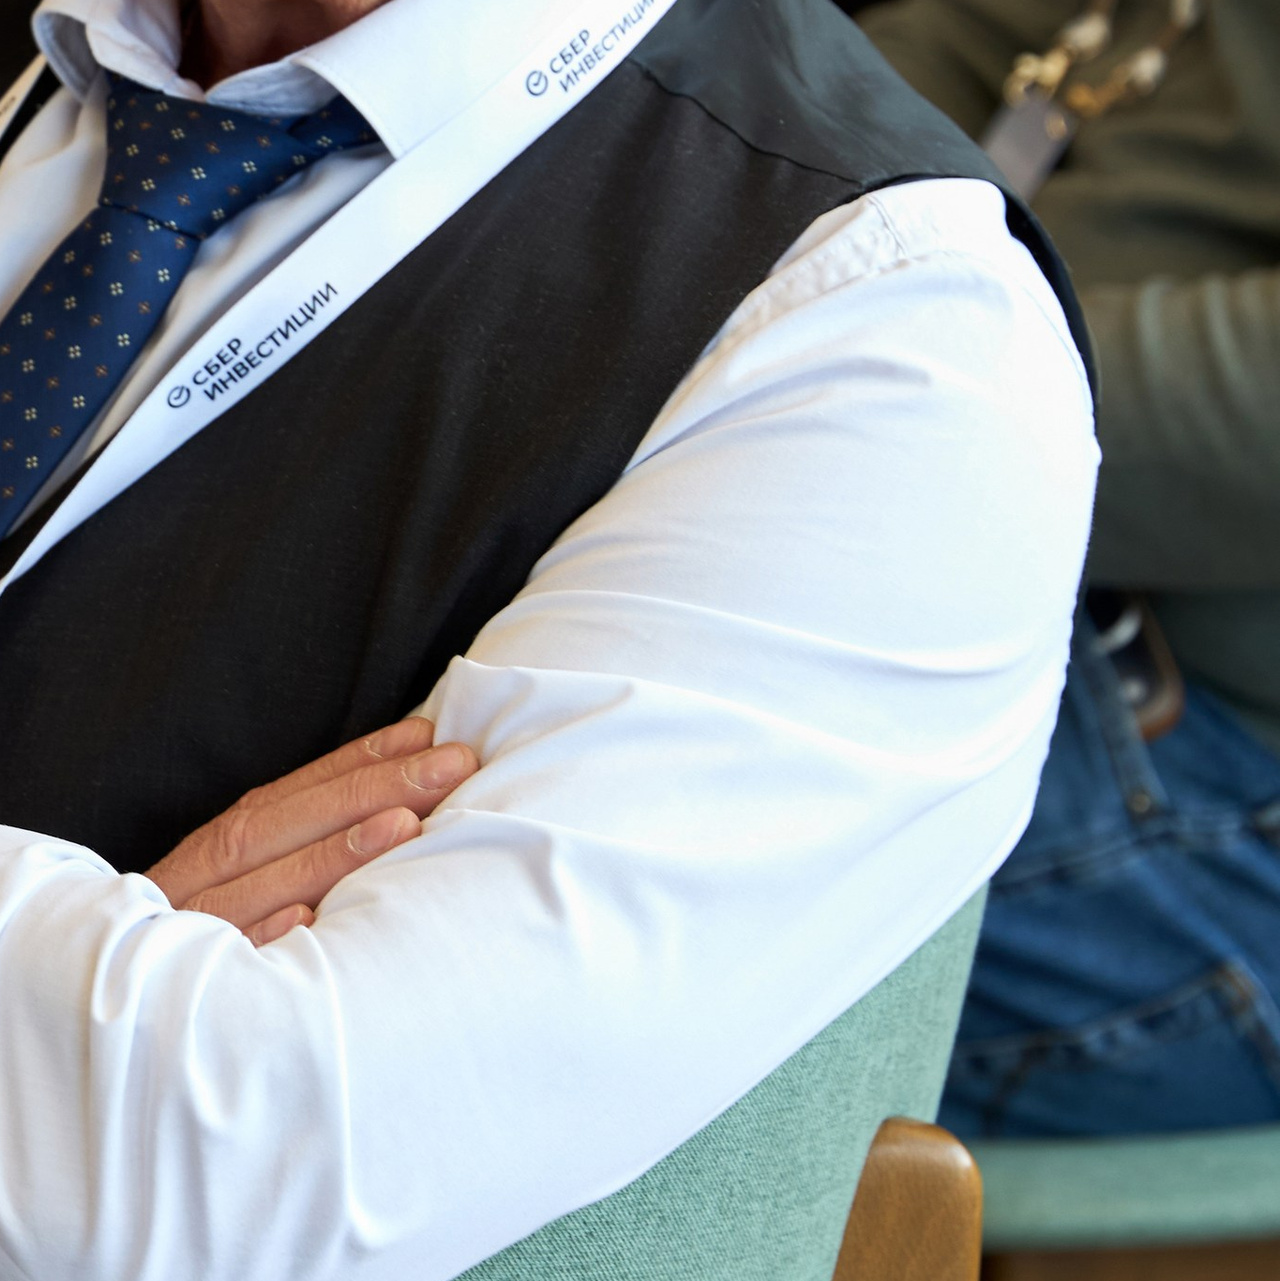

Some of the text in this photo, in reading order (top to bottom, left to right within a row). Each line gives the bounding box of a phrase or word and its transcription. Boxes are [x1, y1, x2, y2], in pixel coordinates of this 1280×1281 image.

[549, 29, 590, 74] СБЕР
[192, 337, 242, 386] СБЕР
[203, 282, 339, 401] ИНВЕСТИЦИИ
